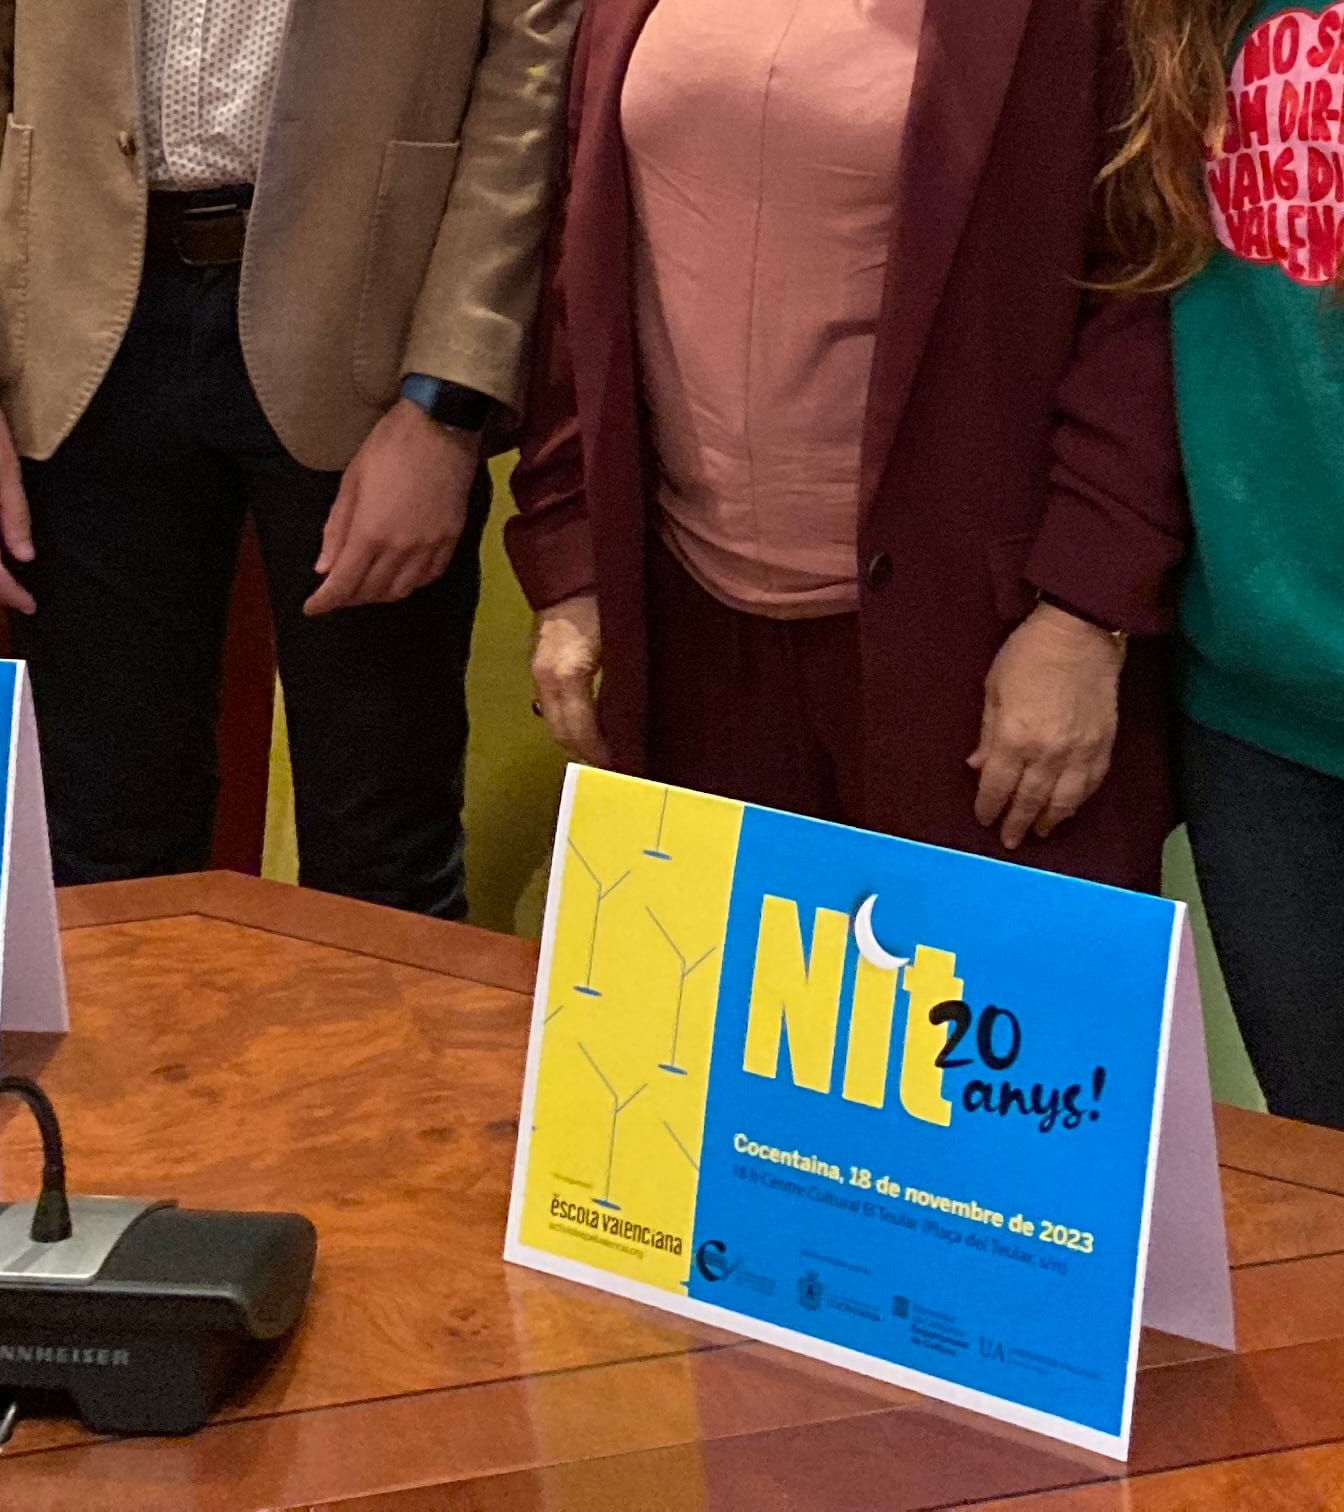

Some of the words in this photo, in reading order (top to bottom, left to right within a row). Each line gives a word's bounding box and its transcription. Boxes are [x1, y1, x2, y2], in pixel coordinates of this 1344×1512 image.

[1243, 15, 1300, 87] NO
[1223, 85, 1269, 154] M
[1208, 146, 1299, 214] VAIG
[742, 893, 964, 1127] Nit
[928, 999, 1022, 1070] 20
[962, 1065, 1107, 1134] anys!
[733, 1132, 845, 1185] Cocentaina,
[848, 1166, 872, 1190] 18
[875, 1175, 901, 1199] de
[904, 1186, 1004, 1228] novembre
[1008, 1213, 1035, 1237] de
[1038, 1219, 1095, 1254] 2023
[602, 1213, 683, 1256] valenciana
